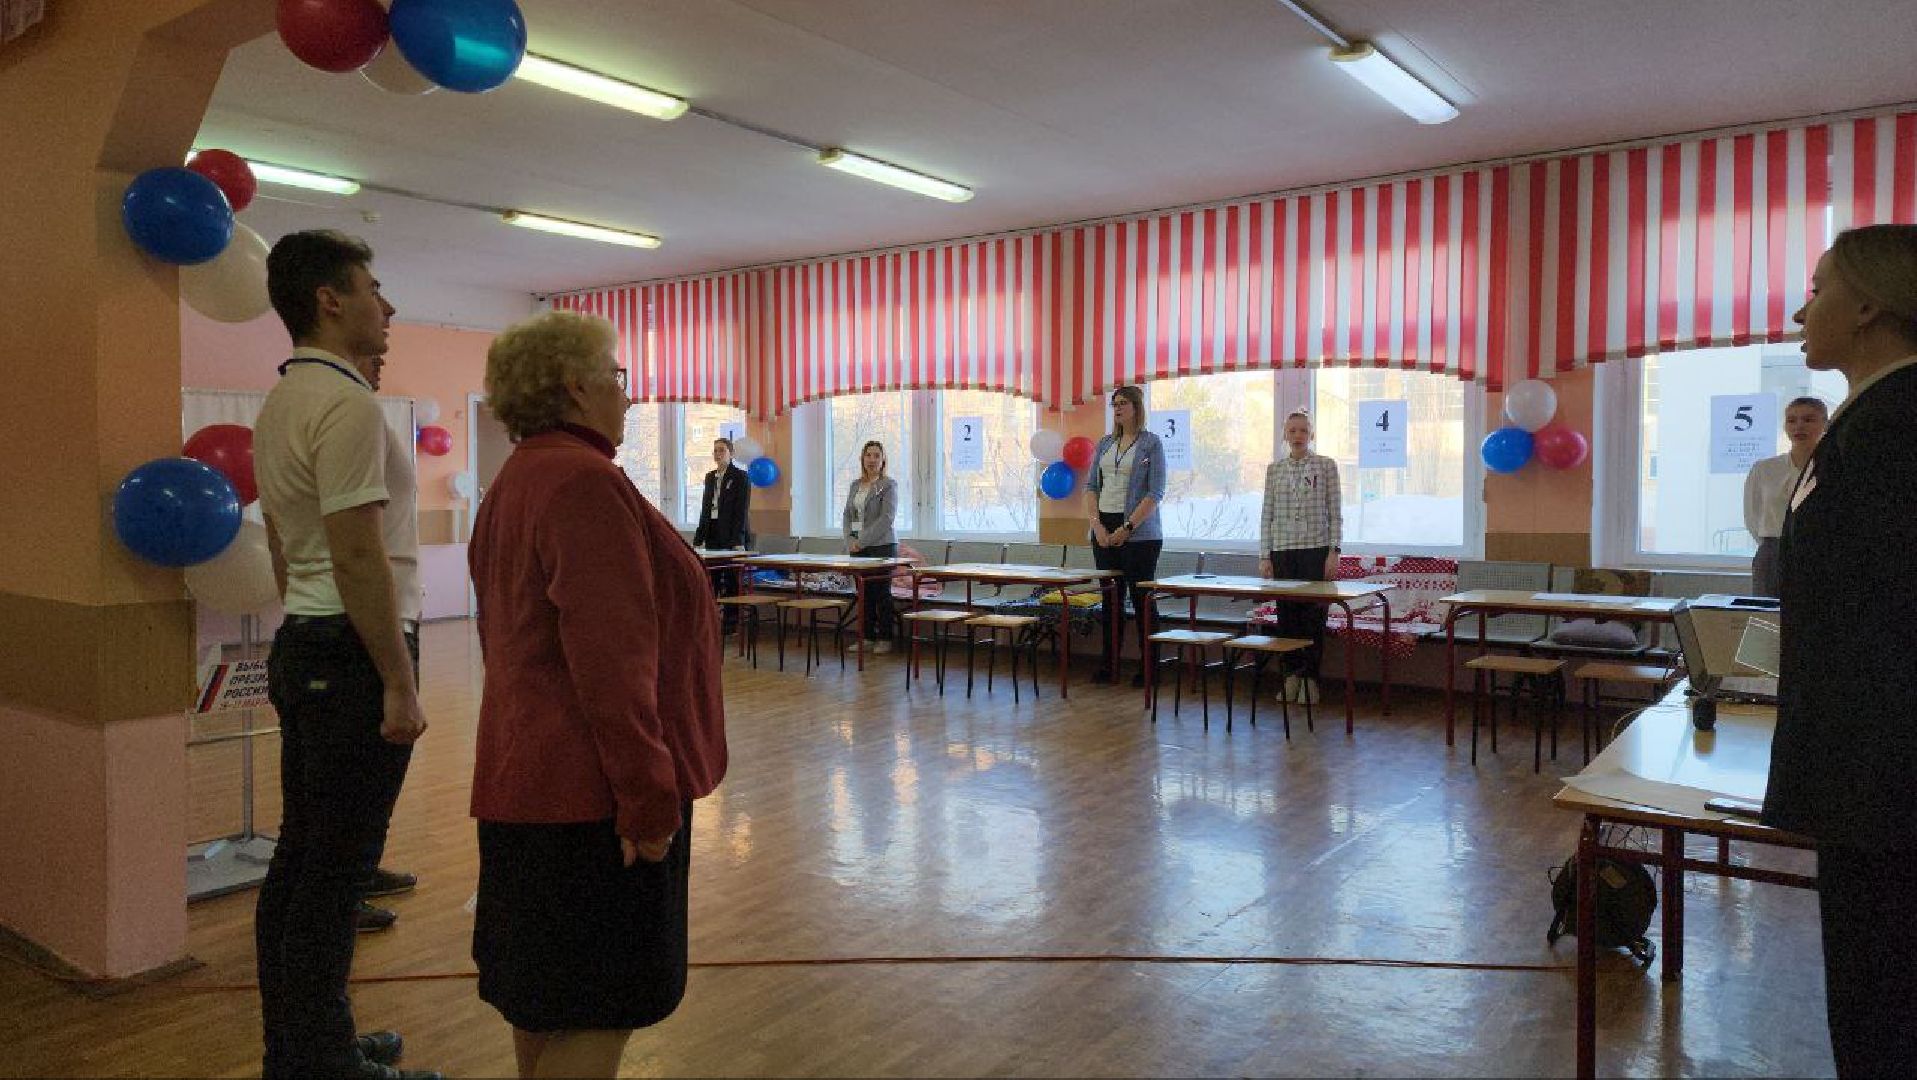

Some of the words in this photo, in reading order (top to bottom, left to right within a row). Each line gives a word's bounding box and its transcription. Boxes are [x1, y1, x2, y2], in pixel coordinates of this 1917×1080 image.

[1164, 418, 1176, 439] 3
[1375, 410, 1389, 431] 4
[1734, 405, 1753, 431] 5
[963, 424, 972, 441] 2
